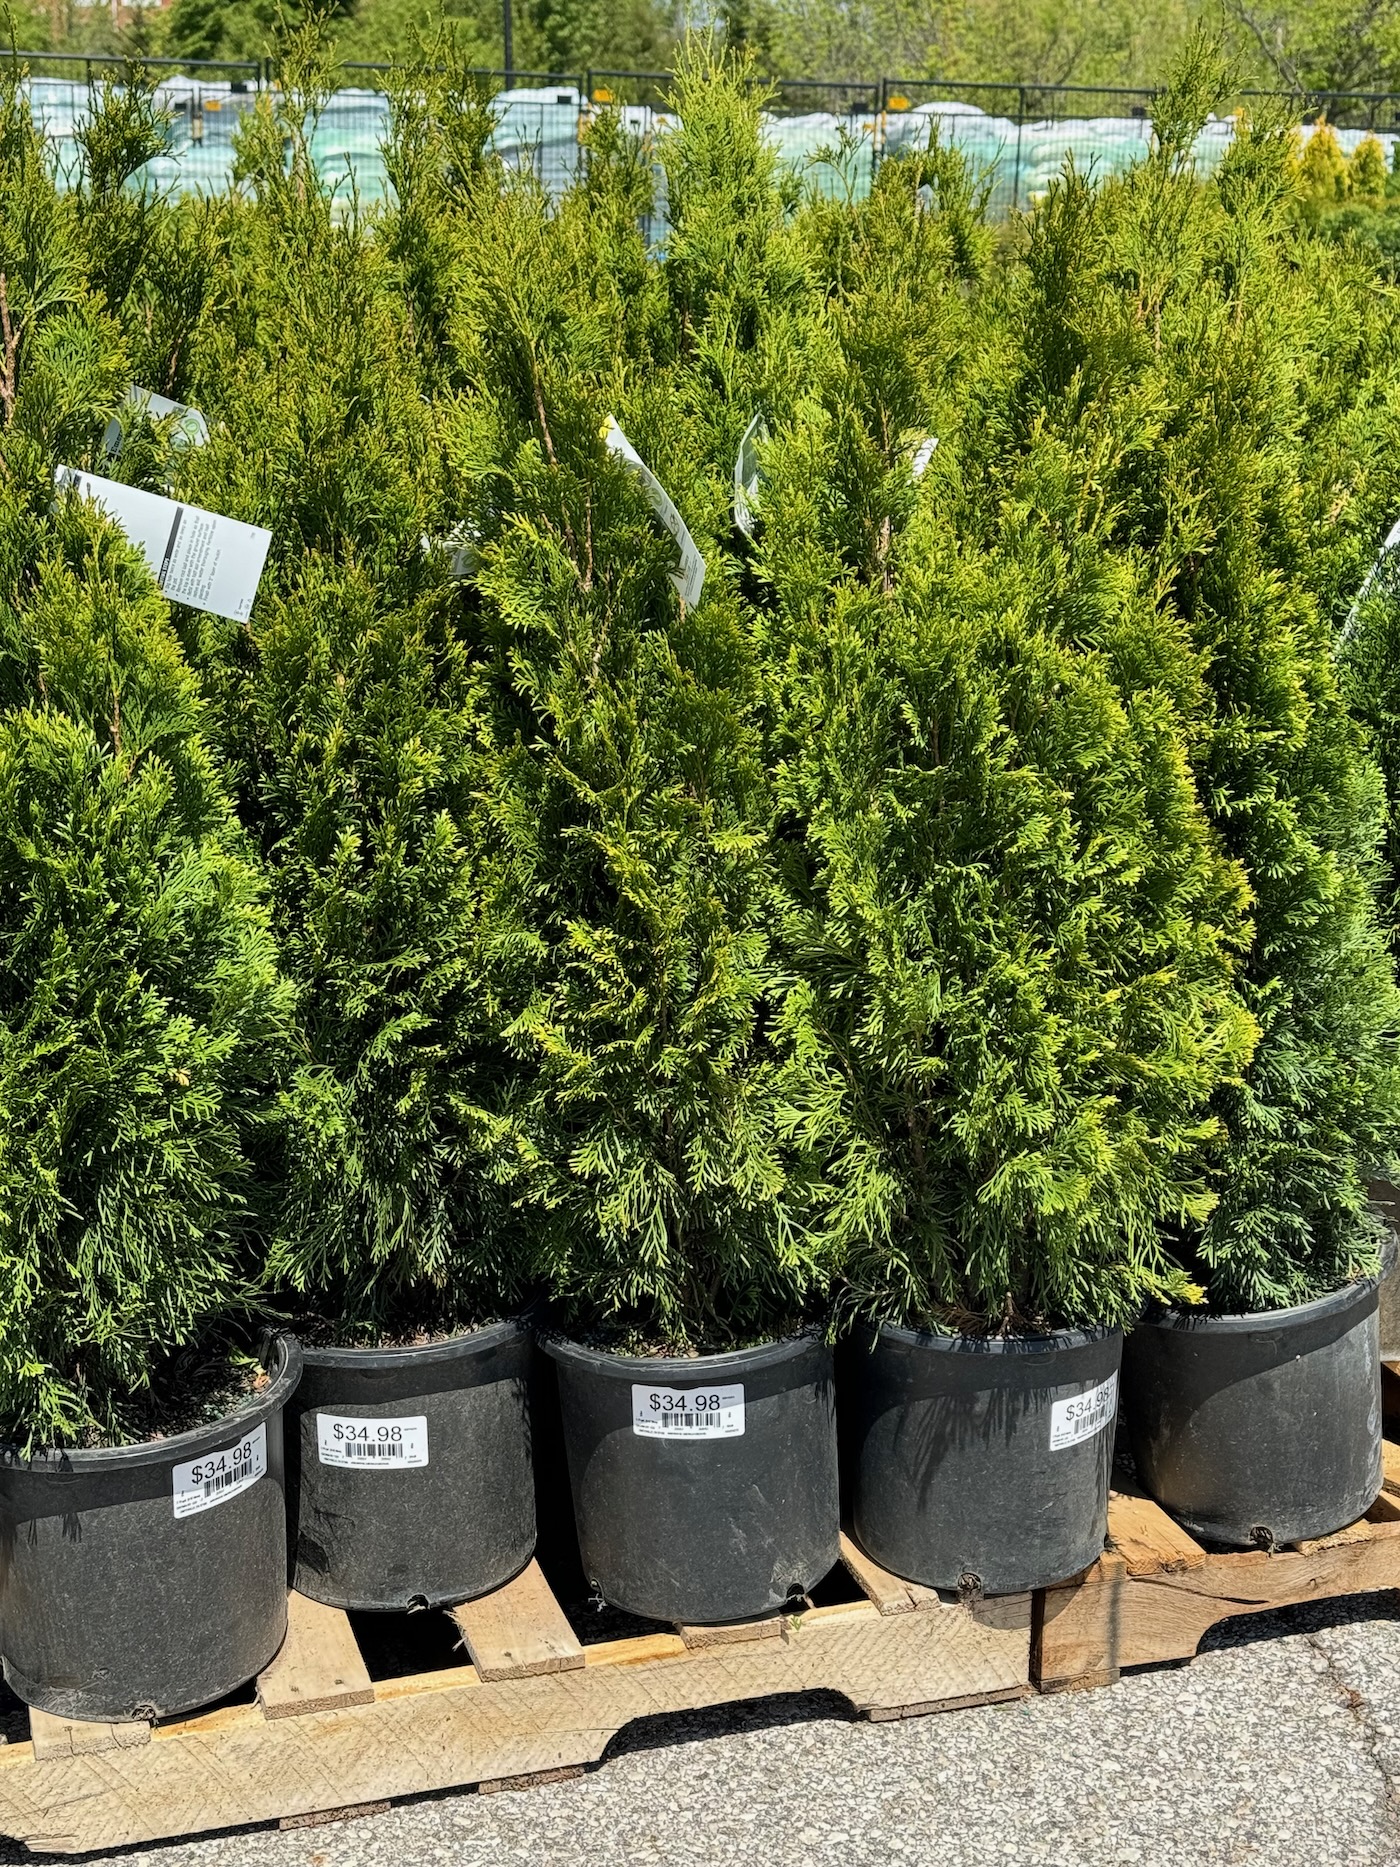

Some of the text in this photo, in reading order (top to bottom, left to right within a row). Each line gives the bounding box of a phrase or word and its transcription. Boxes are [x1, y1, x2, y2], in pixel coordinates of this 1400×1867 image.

[649, 1393, 720, 1411] $34.98
[1066, 1387, 1109, 1420] $34.98
[333, 1423, 402, 1441] $34.98
[192, 1442, 251, 1485] $34.98
